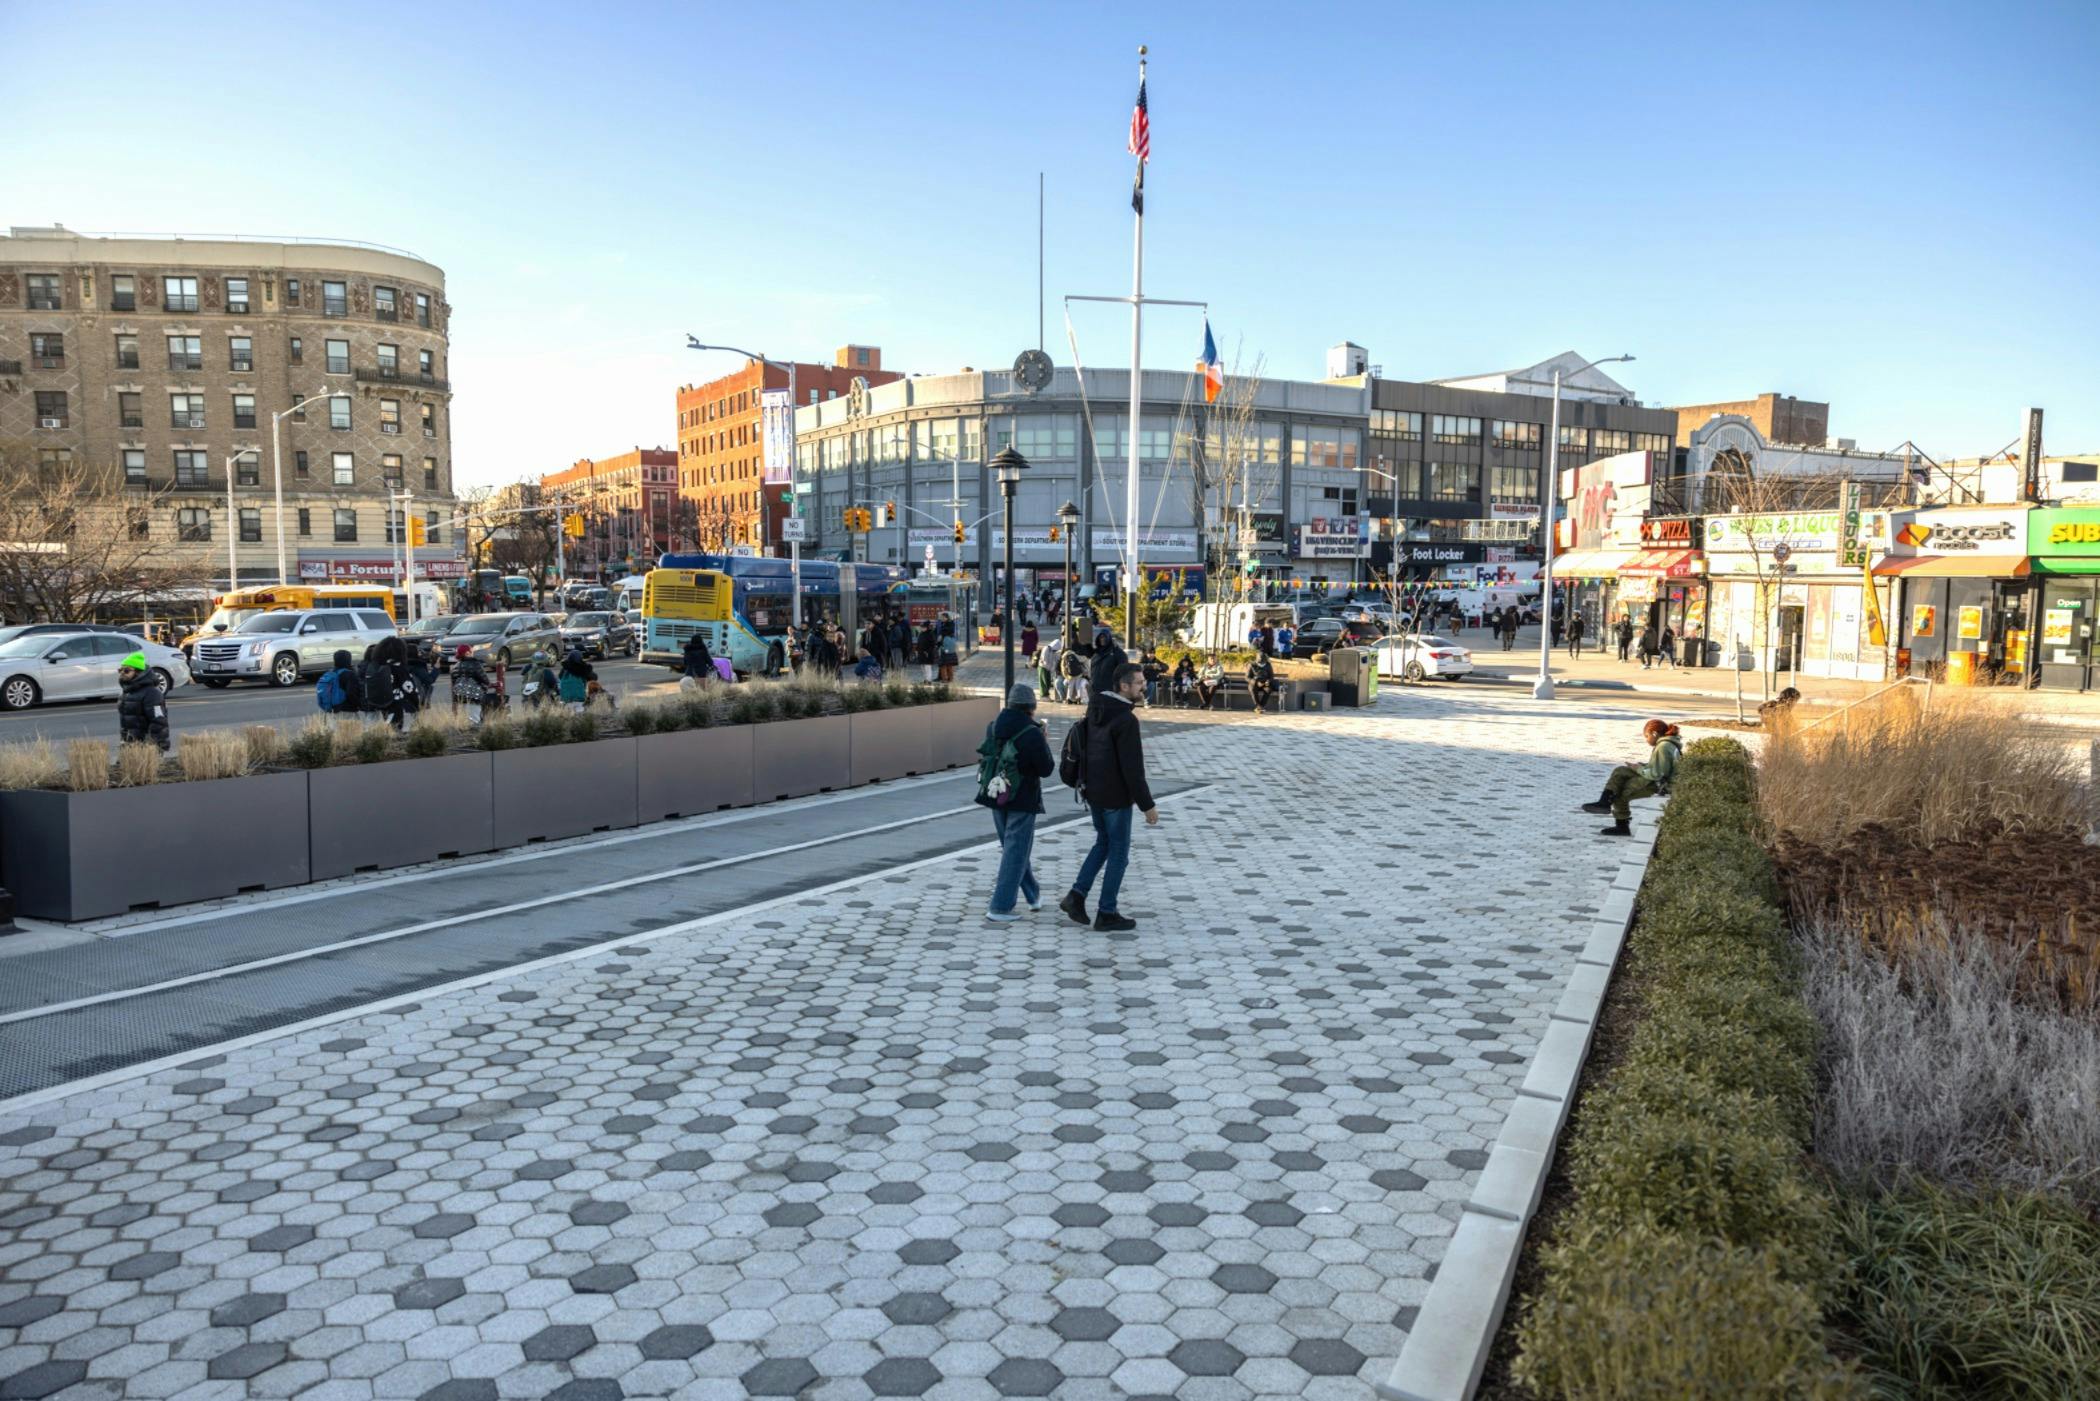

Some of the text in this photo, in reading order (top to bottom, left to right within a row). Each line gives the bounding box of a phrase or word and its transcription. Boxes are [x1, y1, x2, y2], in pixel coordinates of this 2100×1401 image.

[788, 521, 799, 529] NO
[1661, 520, 1691, 539] PIZZA
[1844, 484, 1866, 564] LIQUORS
[1932, 521, 2016, 540] boost
[1933, 541, 1979, 550] mobile
[738, 548, 749, 556] NO
[1412, 548, 1465, 560] Foot Locker
[1476, 565, 1516, 582] FedEx
[2057, 598, 2081, 608] Open
